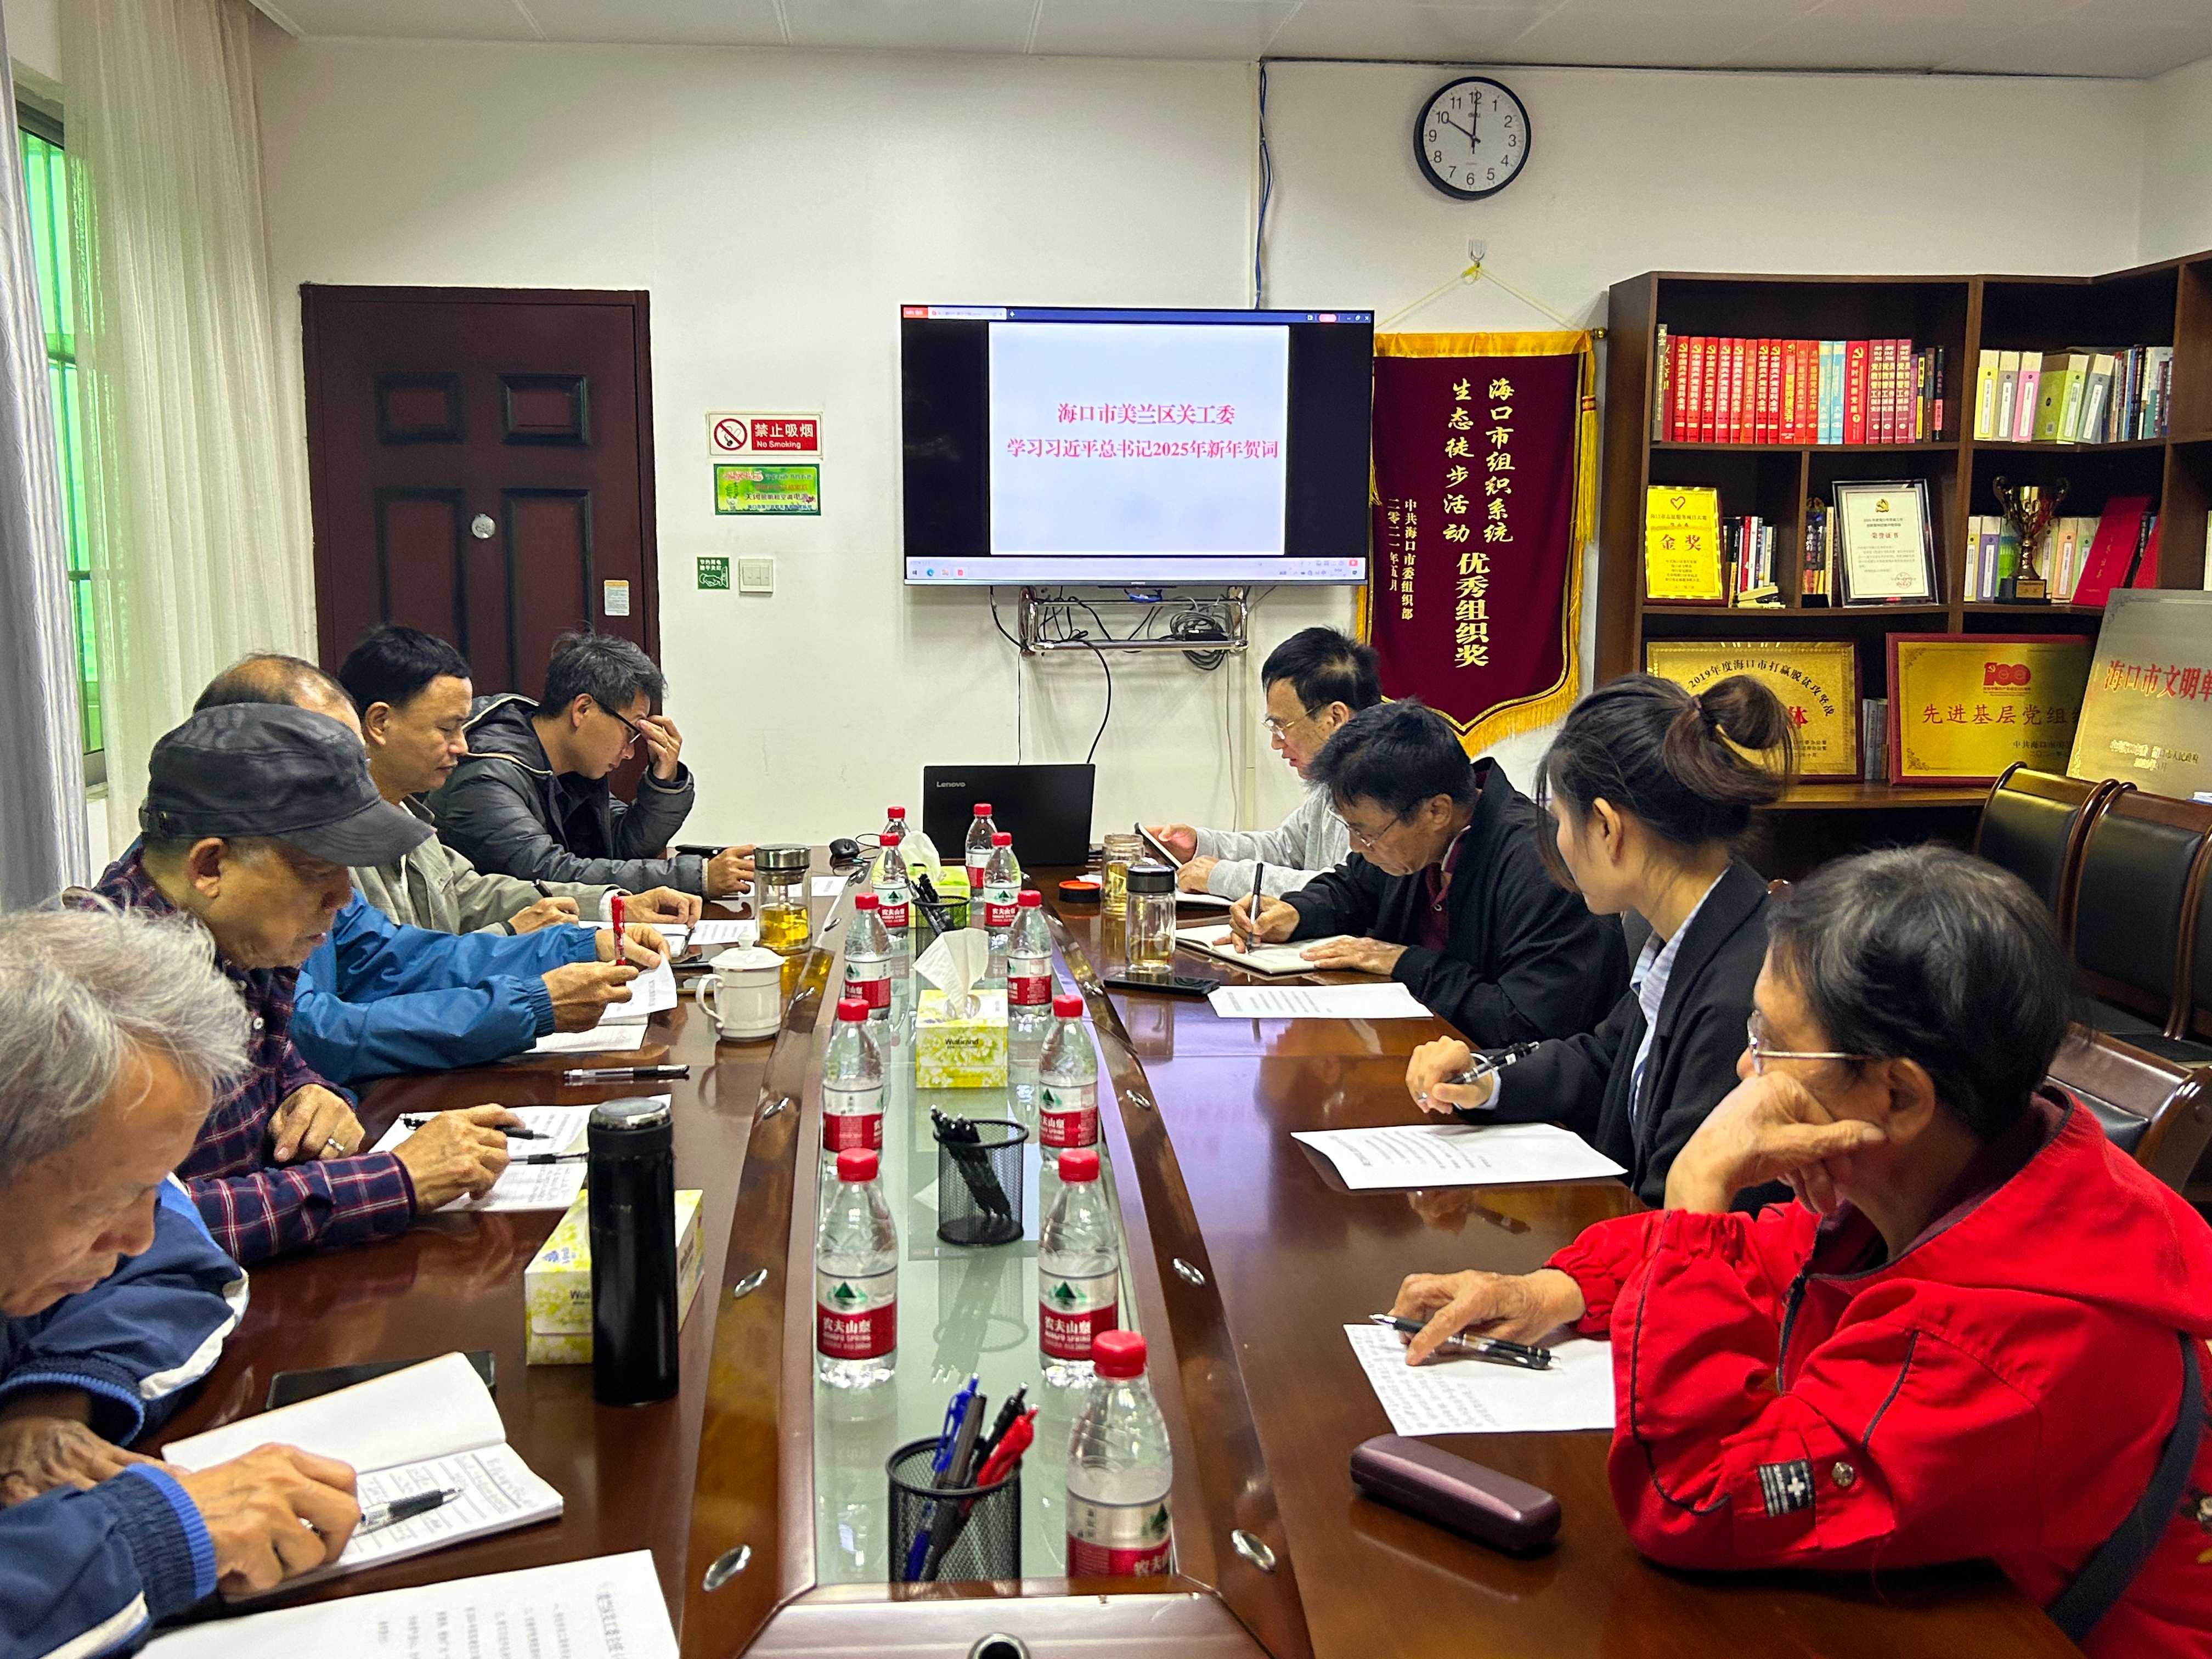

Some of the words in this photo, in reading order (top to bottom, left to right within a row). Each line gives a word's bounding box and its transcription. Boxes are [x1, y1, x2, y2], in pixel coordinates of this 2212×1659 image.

[1450, 97, 1462, 109] 11
[1469, 91, 1482, 104] 12
[1492, 100, 1497, 111] 1
[1436, 111, 1449, 124] 10
[1504, 116, 1513, 128] 2
[1429, 130, 1437, 142] 9
[1509, 135, 1516, 147] 3
[1434, 150, 1442, 163] 8
[1501, 155, 1509, 166] 4
[1448, 166, 1457, 178] 7
[1487, 168, 1495, 180] 5
[1466, 173, 1475, 185] 6
[1058, 403, 1235, 425] 海口市美兰区关工委
[754, 423, 814, 438] 禁止吸烟
[769, 441, 801, 449] Smoking
[1007, 438, 1279, 459] 学习习近平总书记2025年新年贺词
[1443, 378, 1474, 543] 生态徒步活动
[1482, 378, 1516, 543] 海口市组织系统
[1387, 498, 1401, 591] 二零二一年五月
[1659, 534, 1701, 551] 金奖
[1401, 499, 1417, 620] 中共海口市委组织部
[1454, 552, 1491, 668] 优秀组织奖
[823, 1317, 872, 1334] 农夫山泉
[1045, 1316, 1091, 1335] 农夫山泉
